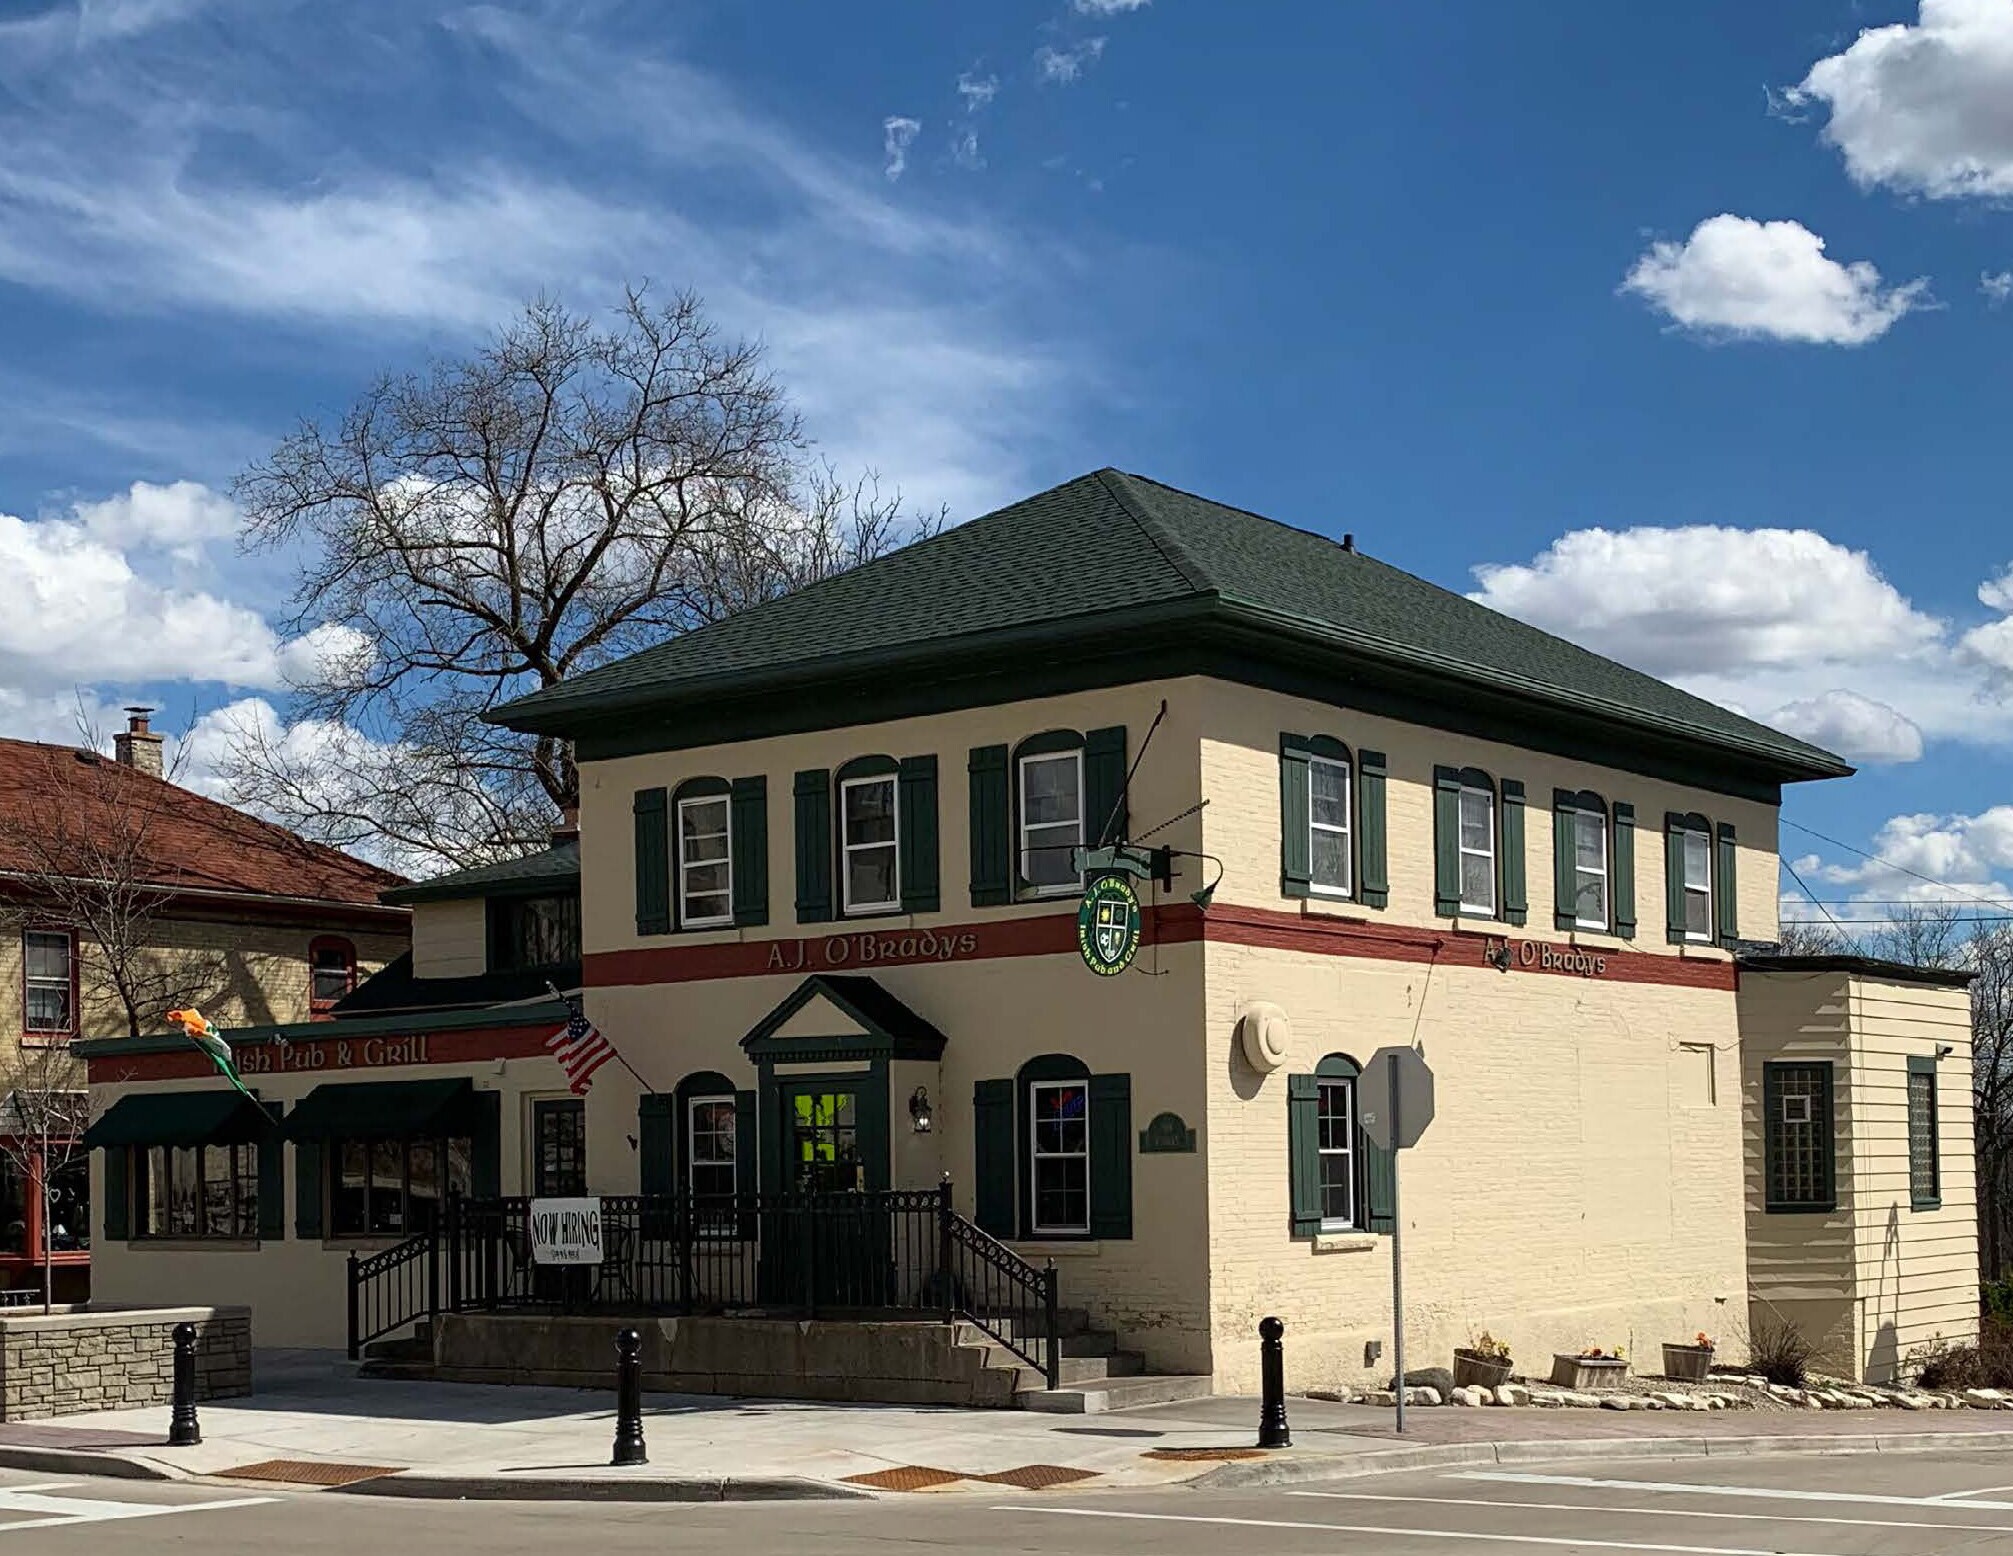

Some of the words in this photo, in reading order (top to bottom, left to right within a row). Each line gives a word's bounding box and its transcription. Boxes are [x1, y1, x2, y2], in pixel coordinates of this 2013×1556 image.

[766, 940, 815, 969] A.J.
[825, 930, 977, 965] O'Bradys
[1089, 957, 1106, 974] Pub
[1107, 961, 1125, 974] and
[1521, 940, 1606, 976] O'Bradys
[280, 1042, 325, 1071] Pub
[337, 1041, 351, 1066] &
[363, 1036, 429, 1065] Grill
[532, 1211, 559, 1248] NOW
[561, 1210, 600, 1251] HIRING
